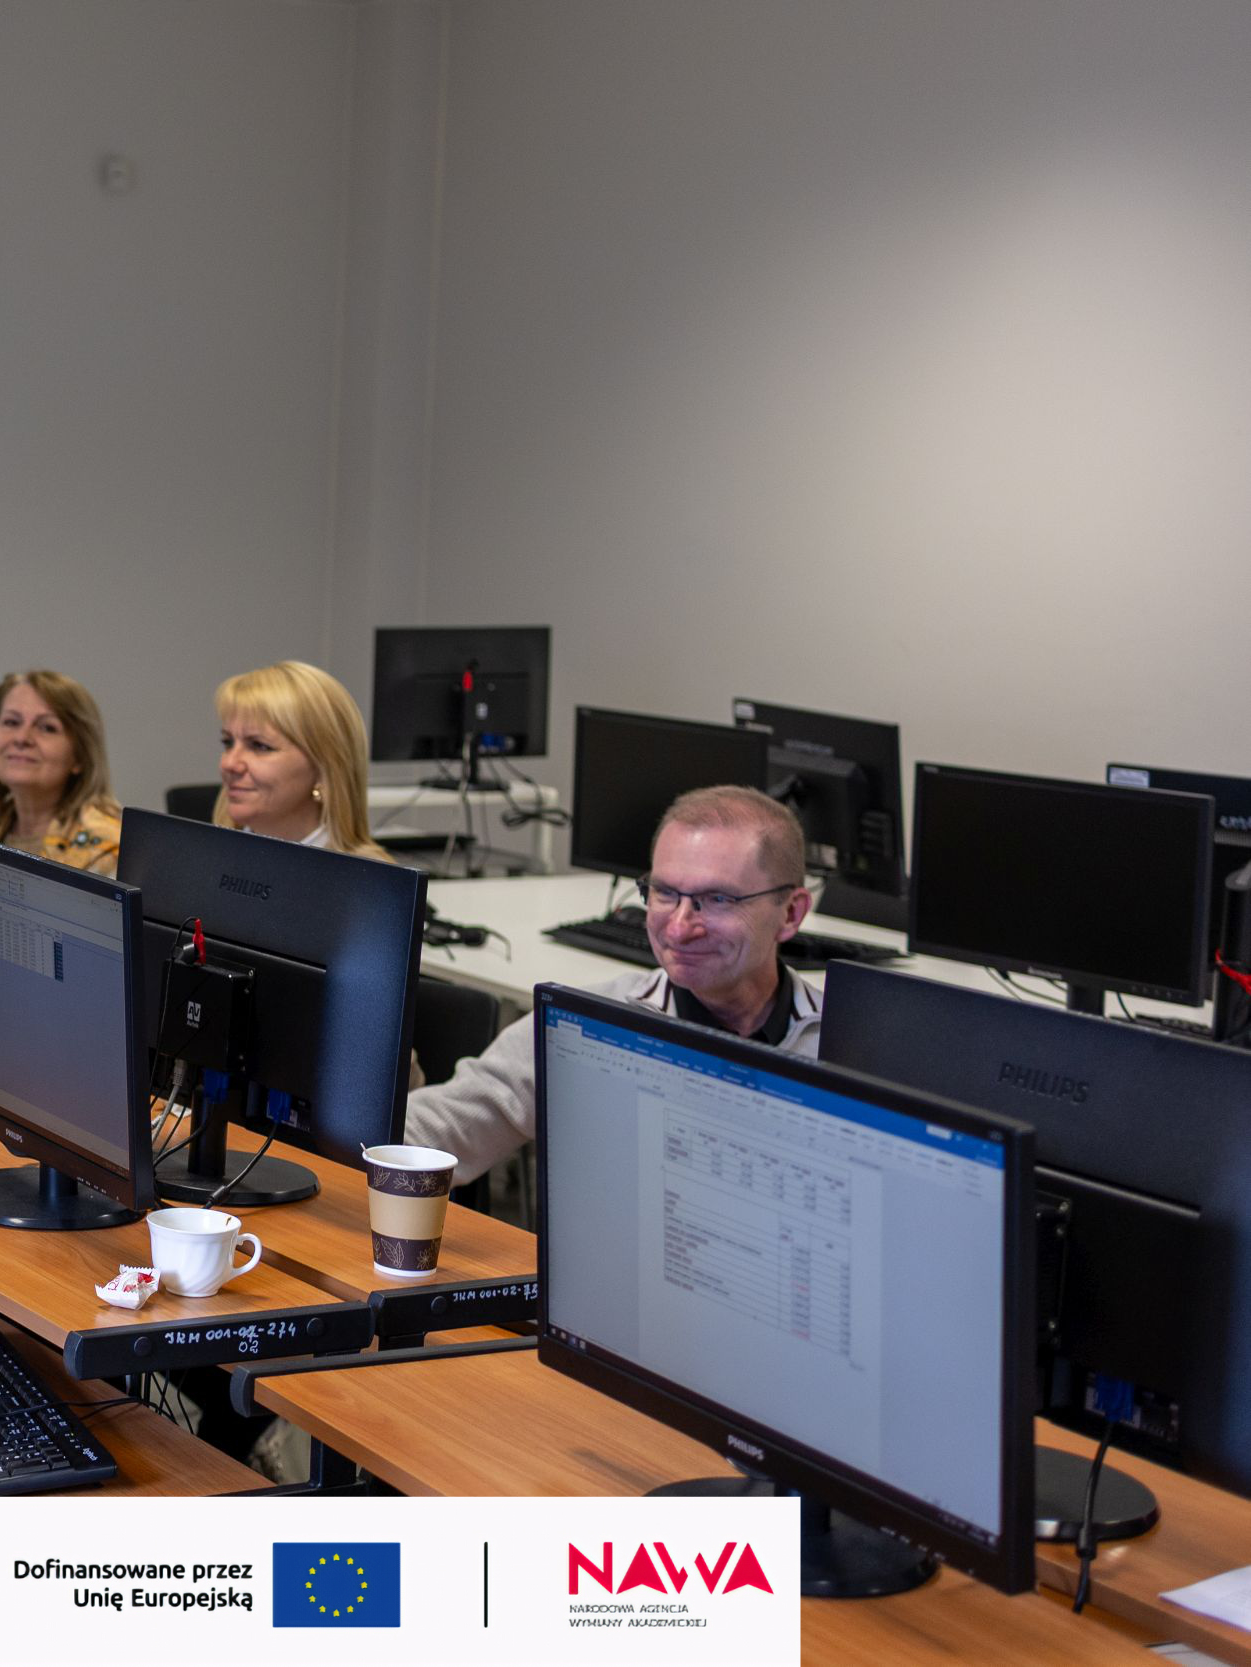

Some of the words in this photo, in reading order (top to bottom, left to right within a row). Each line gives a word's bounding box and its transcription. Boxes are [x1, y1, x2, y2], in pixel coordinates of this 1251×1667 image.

[218, 874, 273, 901] PHILIPS
[998, 1062, 1090, 1104] PHILIPS
[727, 1434, 764, 1461] PHILIPS
